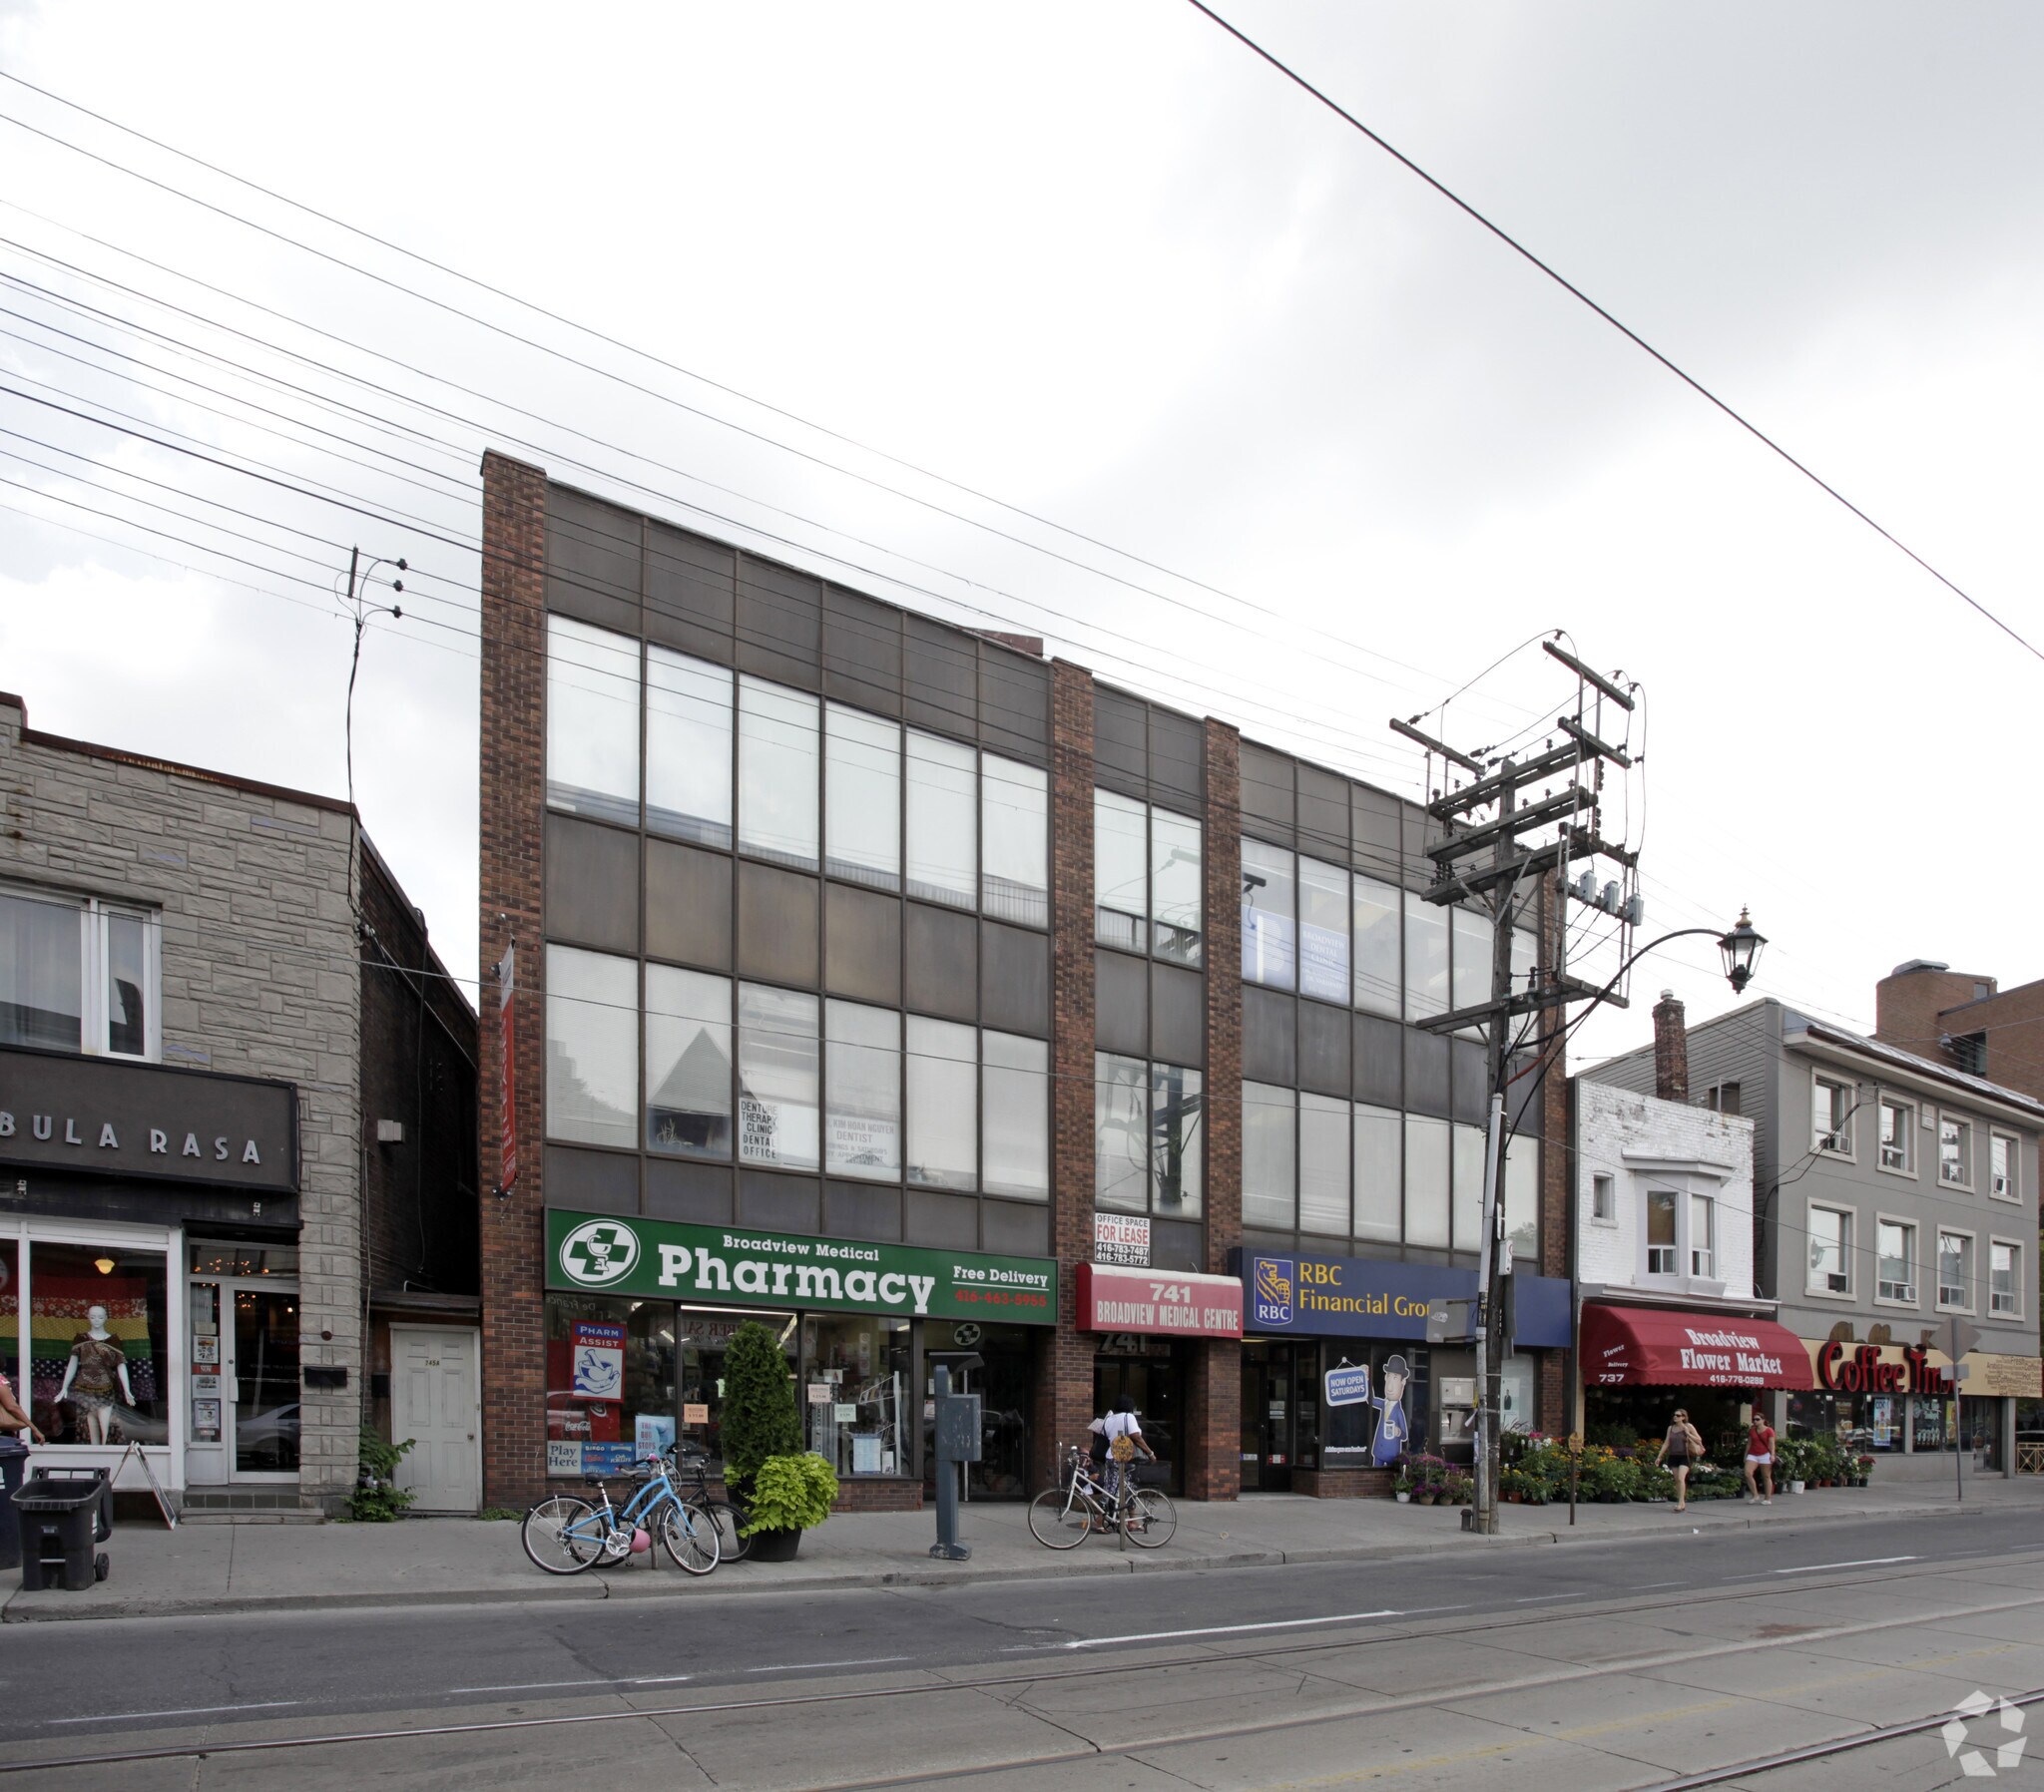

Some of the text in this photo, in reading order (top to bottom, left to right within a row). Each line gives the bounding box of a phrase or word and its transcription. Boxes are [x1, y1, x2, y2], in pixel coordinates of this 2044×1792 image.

[1302, 931, 1345, 948] BROADVIEW
[742, 1101, 777, 1116] DENTURE
[742, 1112, 778, 1125] THERAPY
[747, 1122, 772, 1135] CLINIC
[867, 1122, 894, 1134] NGUYEN
[0, 1112, 260, 1164] BULA RASA
[743, 1134, 775, 1147] DENTAL
[836, 1130, 872, 1143] DENTIST
[744, 1145, 776, 1158] OFFICE
[1097, 1214, 1148, 1228] OFFICE SPACE
[1097, 1224, 1149, 1245] FOR LEASE
[723, 1234, 879, 1261] Broadview Medical
[1097, 1243, 1149, 1256] 416-783-7487
[1096, 1252, 1148, 1265] 416-783-5772
[658, 1243, 935, 1314] Pharmacy
[953, 1265, 1048, 1288] Free Delivery
[1299, 1262, 1342, 1286] RBC
[955, 1289, 1047, 1307] 416-463-5955
[1150, 1283, 1191, 1303] 741
[1299, 1289, 1430, 1317] Financial Gro
[1097, 1300, 1239, 1331] BROADVIEW MEDICAL CENTRE
[1259, 1304, 1289, 1320] RBC
[580, 1326, 619, 1336] PHARM
[580, 1337, 619, 1347] ASSIST
[1685, 1328, 1760, 1350] Broadview
[1603, 1344, 1625, 1358] Flower
[1680, 1348, 1783, 1374] Flower Market
[1817, 1341, 1962, 1394] Coffee Tim
[1330, 1376, 1364, 1387] NOW OPEN
[1599, 1374, 1624, 1383] 737
[1330, 1385, 1364, 1396] SATURDAYS
[550, 1445, 576, 1458] Play
[549, 1457, 578, 1467] Here
